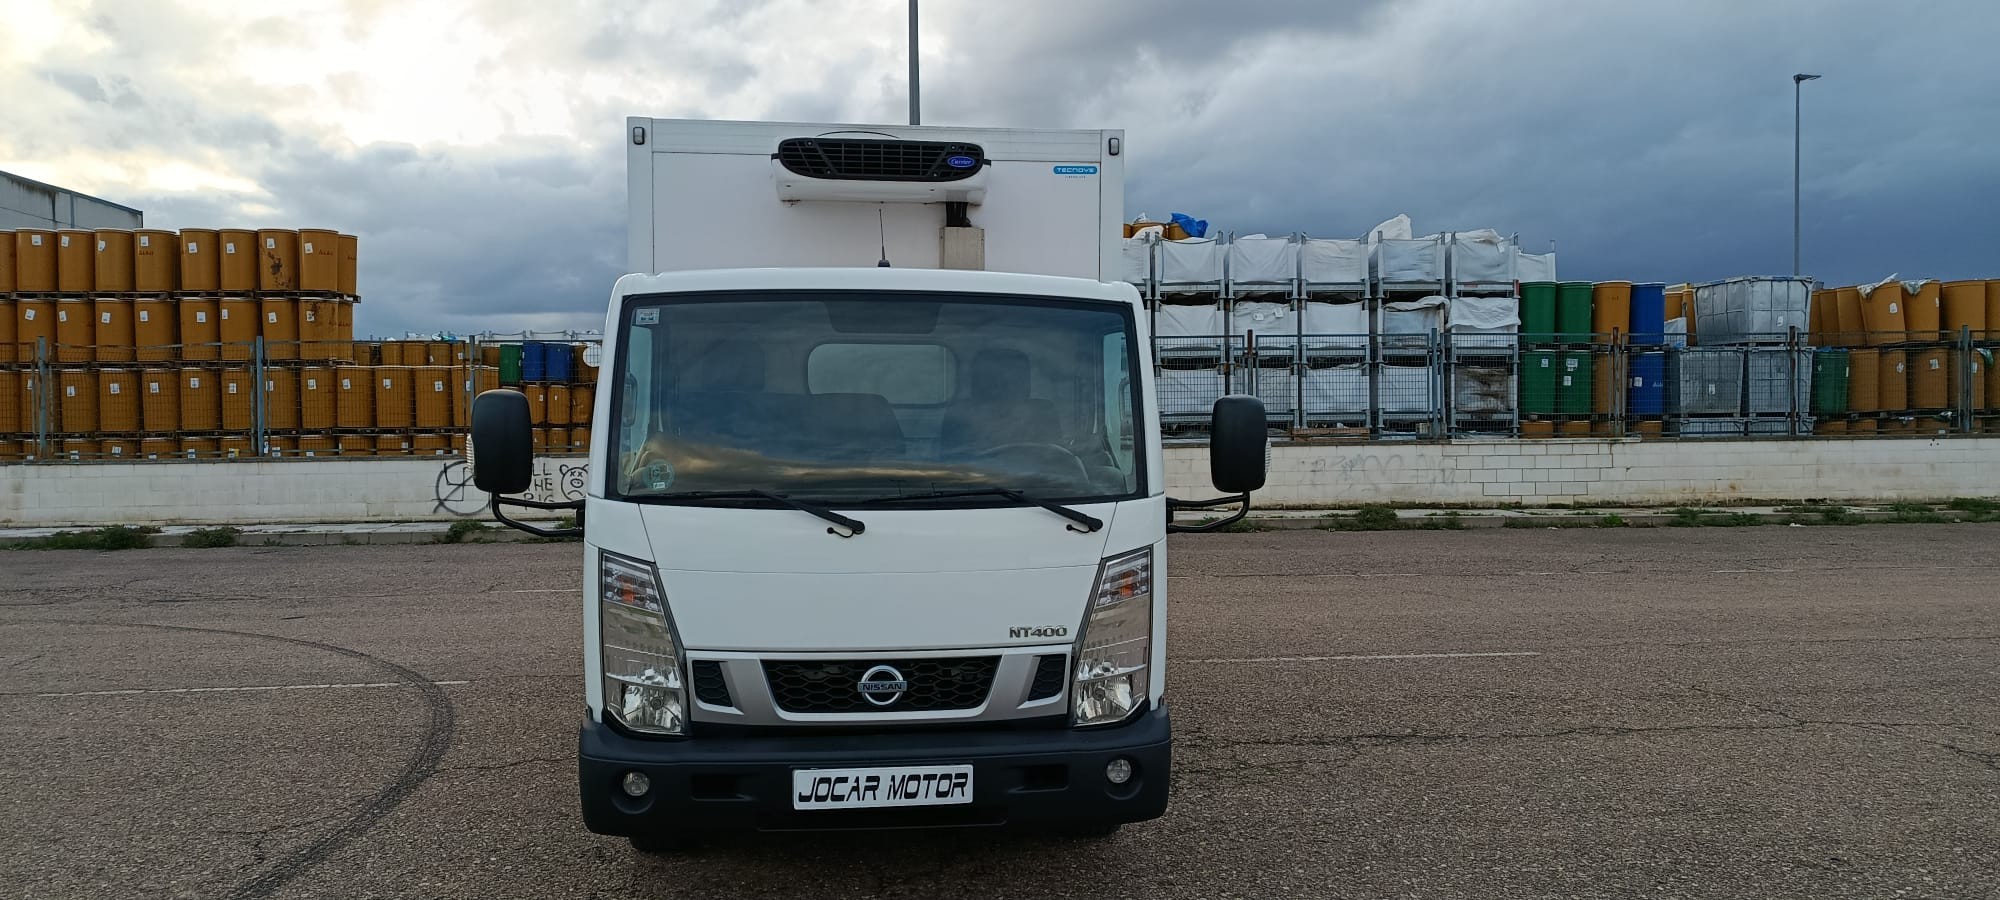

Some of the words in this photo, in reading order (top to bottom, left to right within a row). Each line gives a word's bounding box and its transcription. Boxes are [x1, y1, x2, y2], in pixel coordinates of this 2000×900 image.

[533, 463, 552, 476] LL
[529, 478, 553, 491] HE
[1009, 626, 1067, 638] NT400
[799, 776, 880, 803] JOCAR
[887, 773, 968, 800] MOTOR
